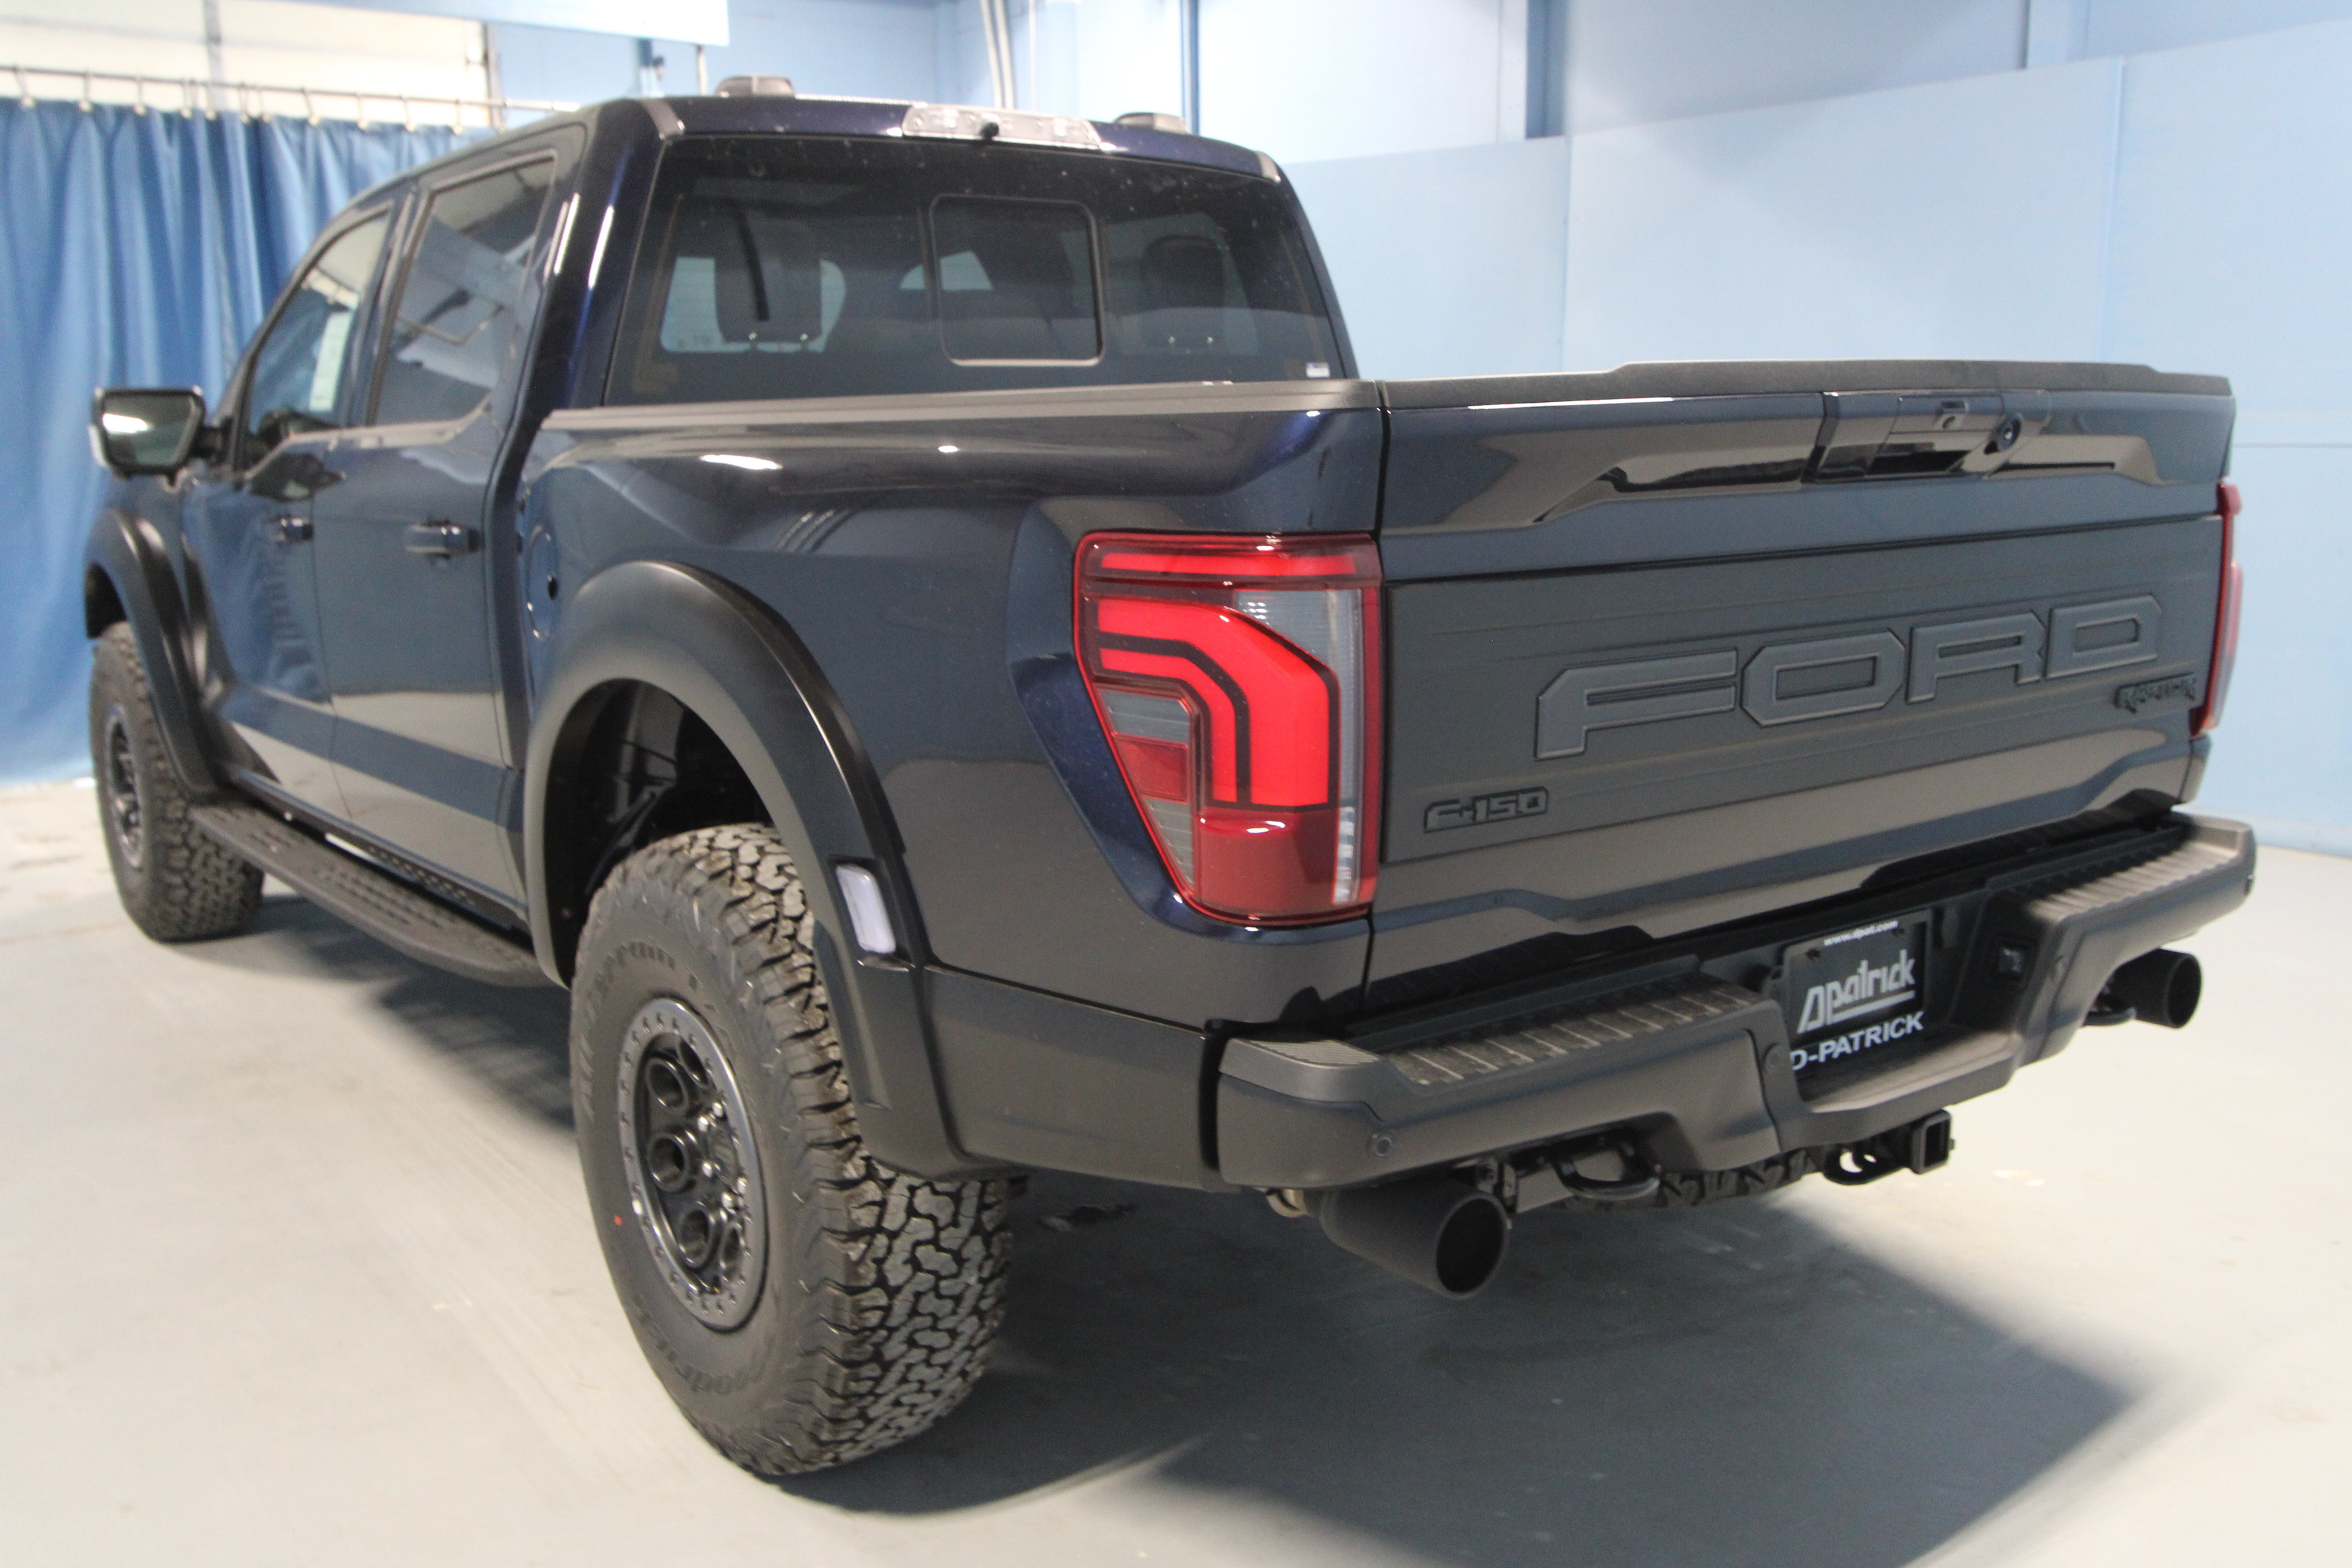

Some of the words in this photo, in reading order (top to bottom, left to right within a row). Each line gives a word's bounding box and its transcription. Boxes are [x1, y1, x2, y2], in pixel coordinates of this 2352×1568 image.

[1535, 594, 2160, 760] FORD
[1423, 786, 1549, 833] F-150
[1790, 1011, 1924, 1071] D-PATRICK
